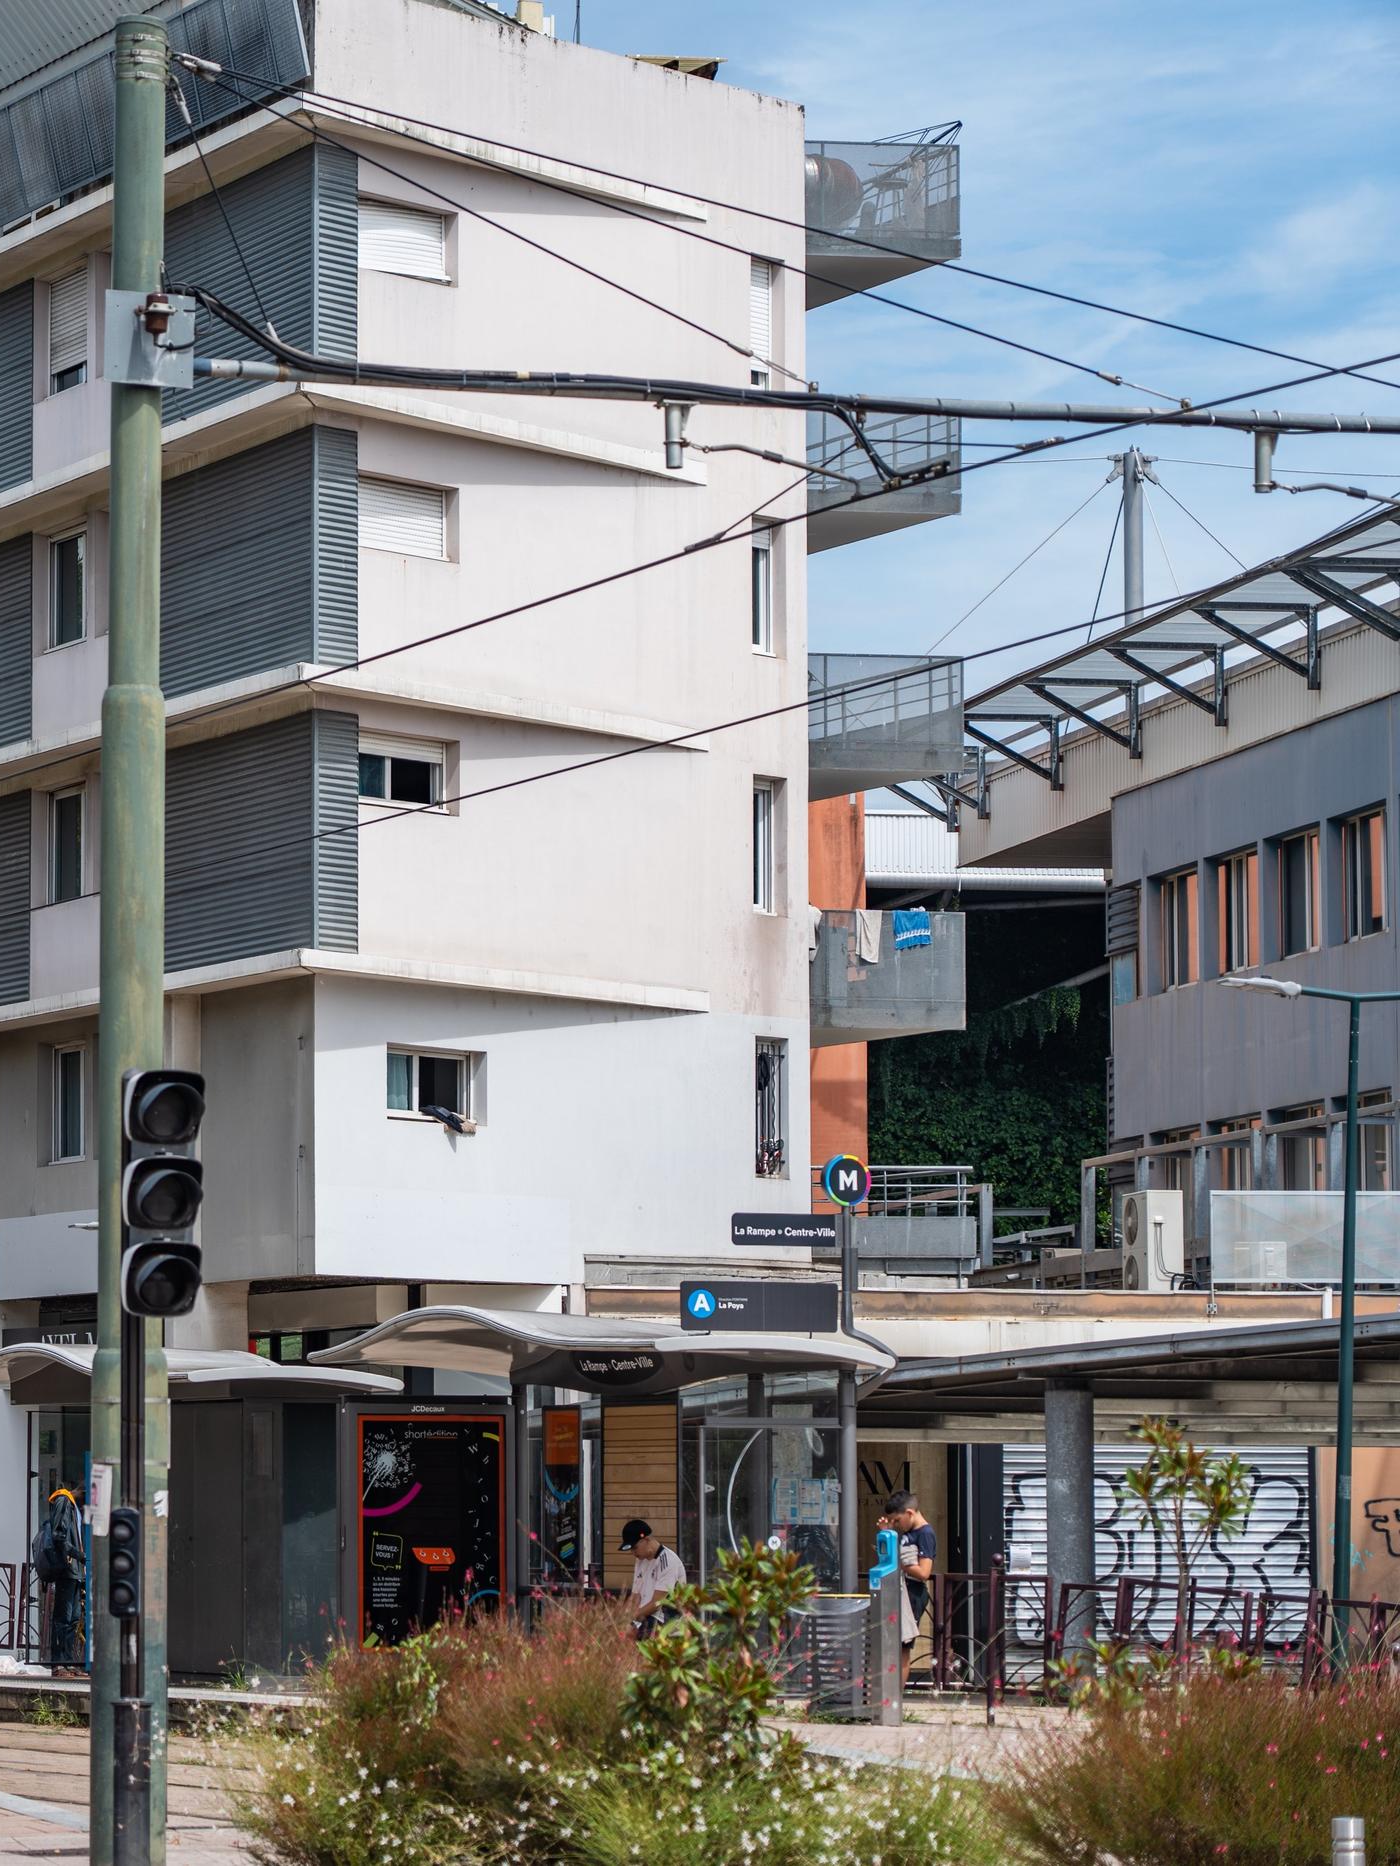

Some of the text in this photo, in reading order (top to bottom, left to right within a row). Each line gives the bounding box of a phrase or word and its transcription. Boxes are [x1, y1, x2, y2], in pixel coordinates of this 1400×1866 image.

[838, 1169, 858, 1191] M
[734, 1226, 836, 1238] La Rampe Centre-Ville
[693, 1294, 710, 1312] A
[728, 1302, 744, 1311] Poya
[581, 1356, 654, 1373] La Rampe Centre-Ville
[411, 1405, 445, 1413] JCDecaux
[376, 1544, 399, 1552] SERVEZ-
[375, 1551, 391, 1559] VOUS
